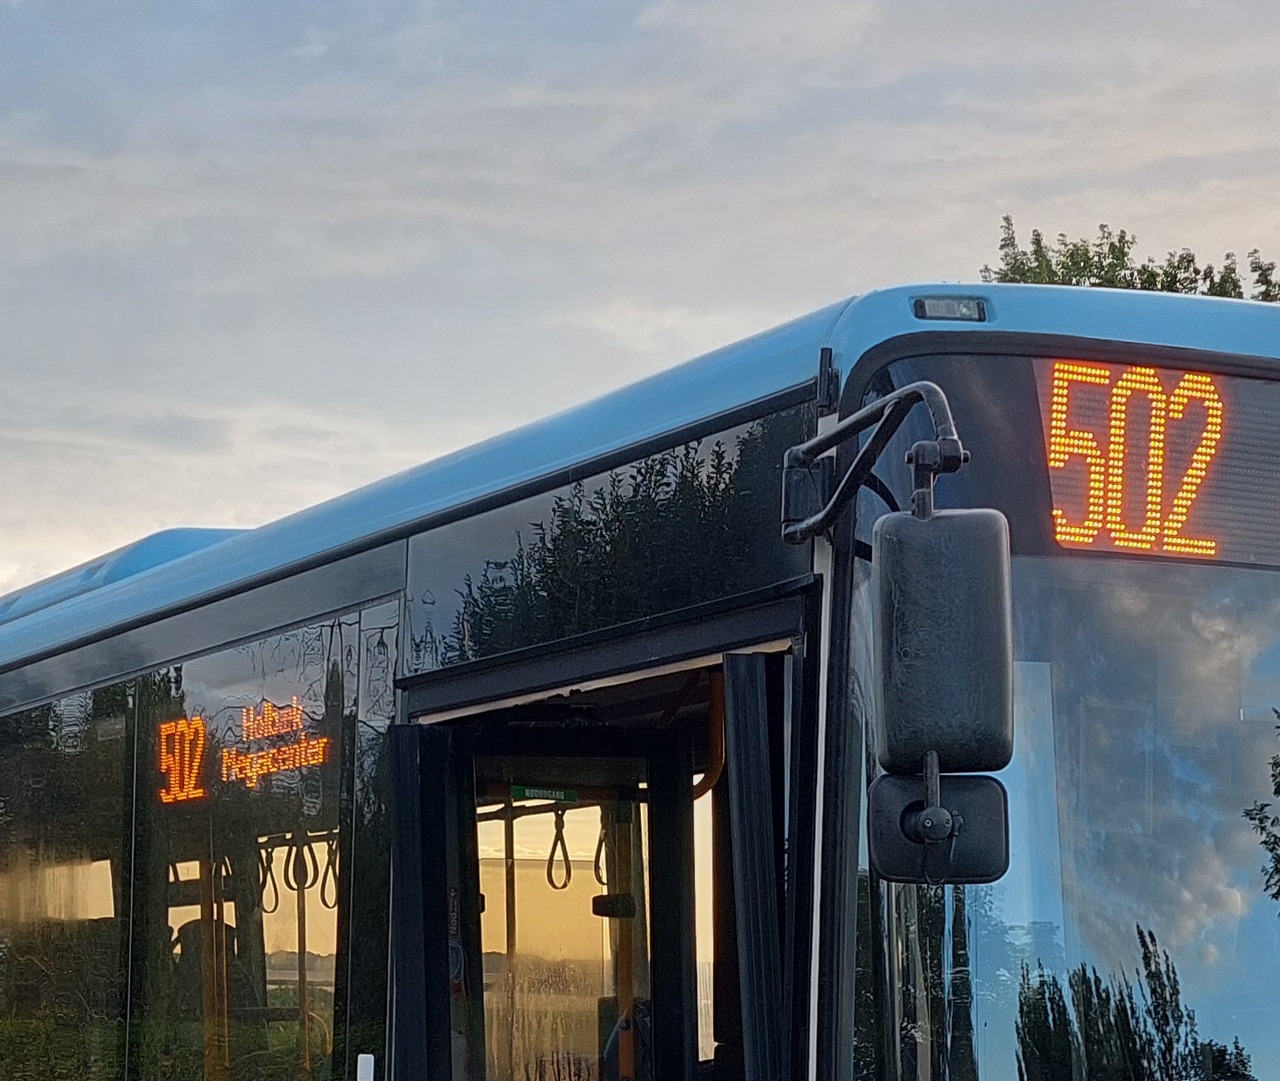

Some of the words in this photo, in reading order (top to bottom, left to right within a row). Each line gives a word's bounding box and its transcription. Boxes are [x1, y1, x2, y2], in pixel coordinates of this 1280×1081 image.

[1049, 362, 1223, 555] 502
[242, 695, 303, 743] Holbæk
[160, 715, 205, 803] 502
[222, 734, 328, 788] Megacenter
